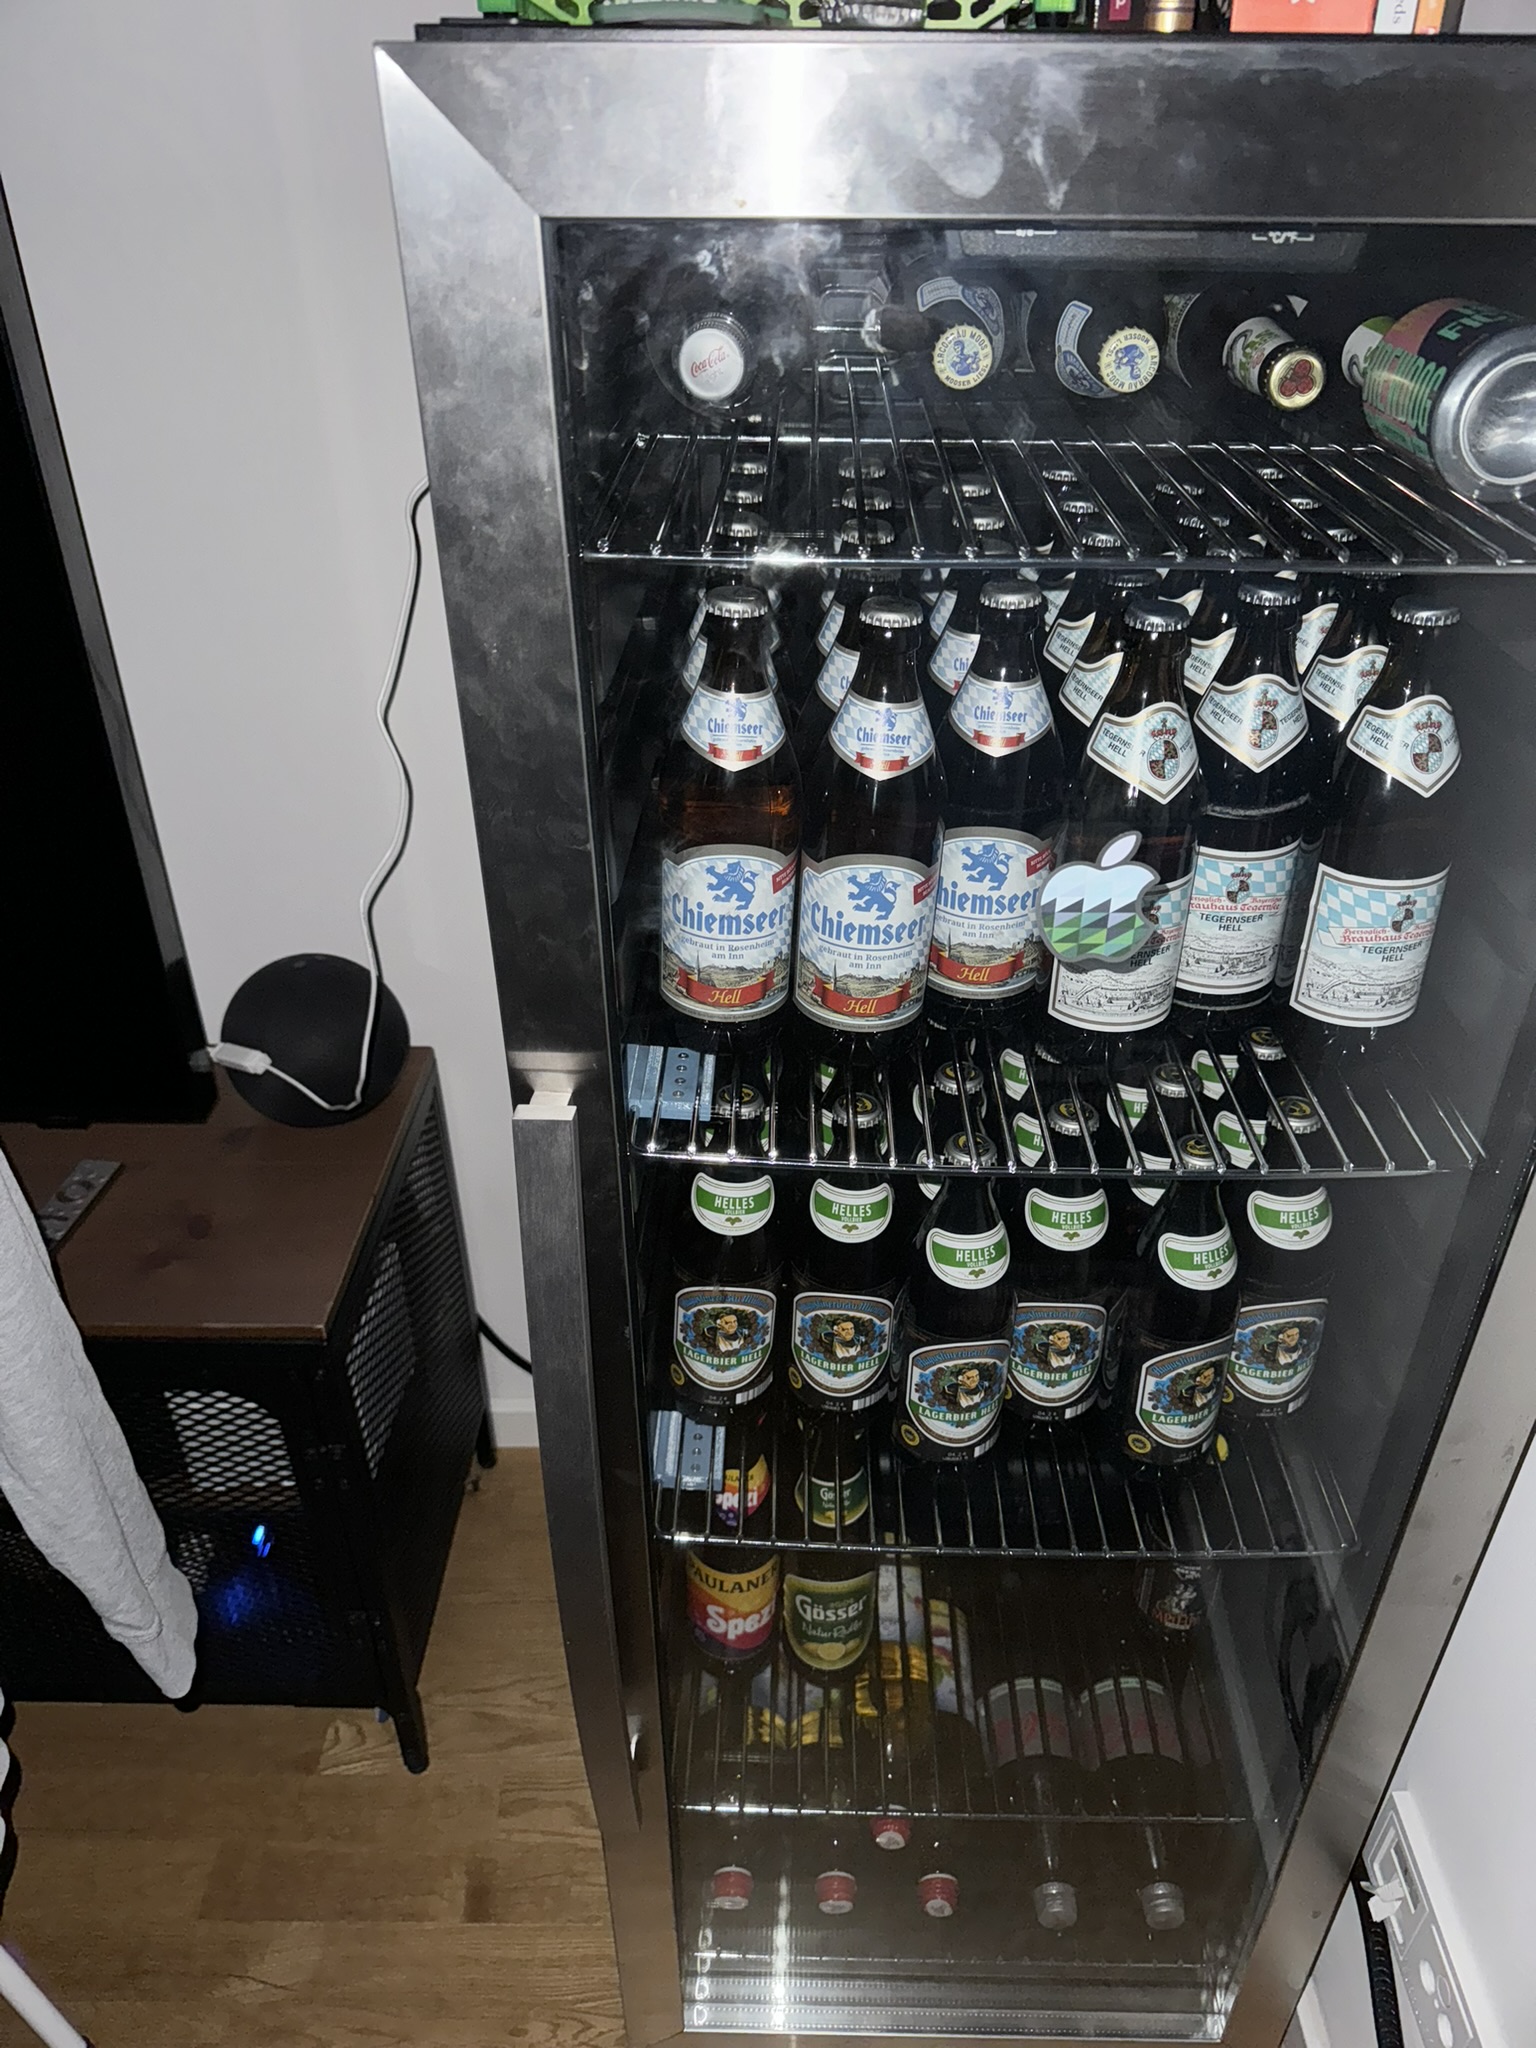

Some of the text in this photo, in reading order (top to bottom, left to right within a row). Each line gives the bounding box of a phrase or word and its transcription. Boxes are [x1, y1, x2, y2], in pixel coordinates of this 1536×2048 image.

[969, 331, 988, 351] MOOS
[1189, 662, 1207, 677] HELL
[1072, 684, 1088, 702] HELL
[1319, 680, 1337, 696] HELL
[1210, 708, 1226, 725] HELL
[707, 717, 763, 736] Chieseer
[1369, 734, 1390, 750] HELL
[1107, 742, 1128, 759] HELL
[937, 875, 1040, 916] hiemseer
[671, 892, 786, 936] Chiemseer
[1190, 901, 1239, 912] rauhaus
[811, 901, 926, 945] Chiemseer
[967, 921, 976, 930] in
[979, 921, 1026, 931] Rosenheim
[1199, 912, 1264, 924] TEGERNSEER
[979, 931, 994, 939] Inn
[1218, 923, 1243, 932] HELL
[681, 935, 775, 952] gebraut in Rosenheim
[1342, 933, 1402, 943] Brauhaus
[818, 944, 913, 962] gebraut in Rosenheim
[1130, 944, 1171, 960] ERNSEER
[1361, 940, 1422, 955] TEGERNSEER
[728, 952, 745, 960] Inn
[1130, 957, 1153, 968] HELL
[1381, 953, 1405, 963] HELL
[849, 961, 882, 970] am Inn
[957, 967, 991, 982] Hell
[707, 988, 741, 1005] Hell
[843, 998, 878, 1015] Hell
[714, 1195, 755, 1210] HELLES
[831, 1202, 872, 1217] HELLES
[1051, 1210, 1092, 1225] HELLES
[1279, 1206, 1319, 1224] HELLES
[955, 1244, 996, 1262] HELLES
[1193, 1244, 1229, 1266] HELLES
[683, 1346, 762, 1366] LAGERBIER HELL
[800, 1350, 879, 1371] LAGERBIER HELL
[1011, 1361, 1092, 1381] LAGERBIER HELL
[1234, 1364, 1294, 1379] LAGERBIER
[918, 1406, 977, 1421] LAGERBIER
[1152, 1409, 1209, 1424] LAGERBIER
[795, 1593, 868, 1622] Gösser
